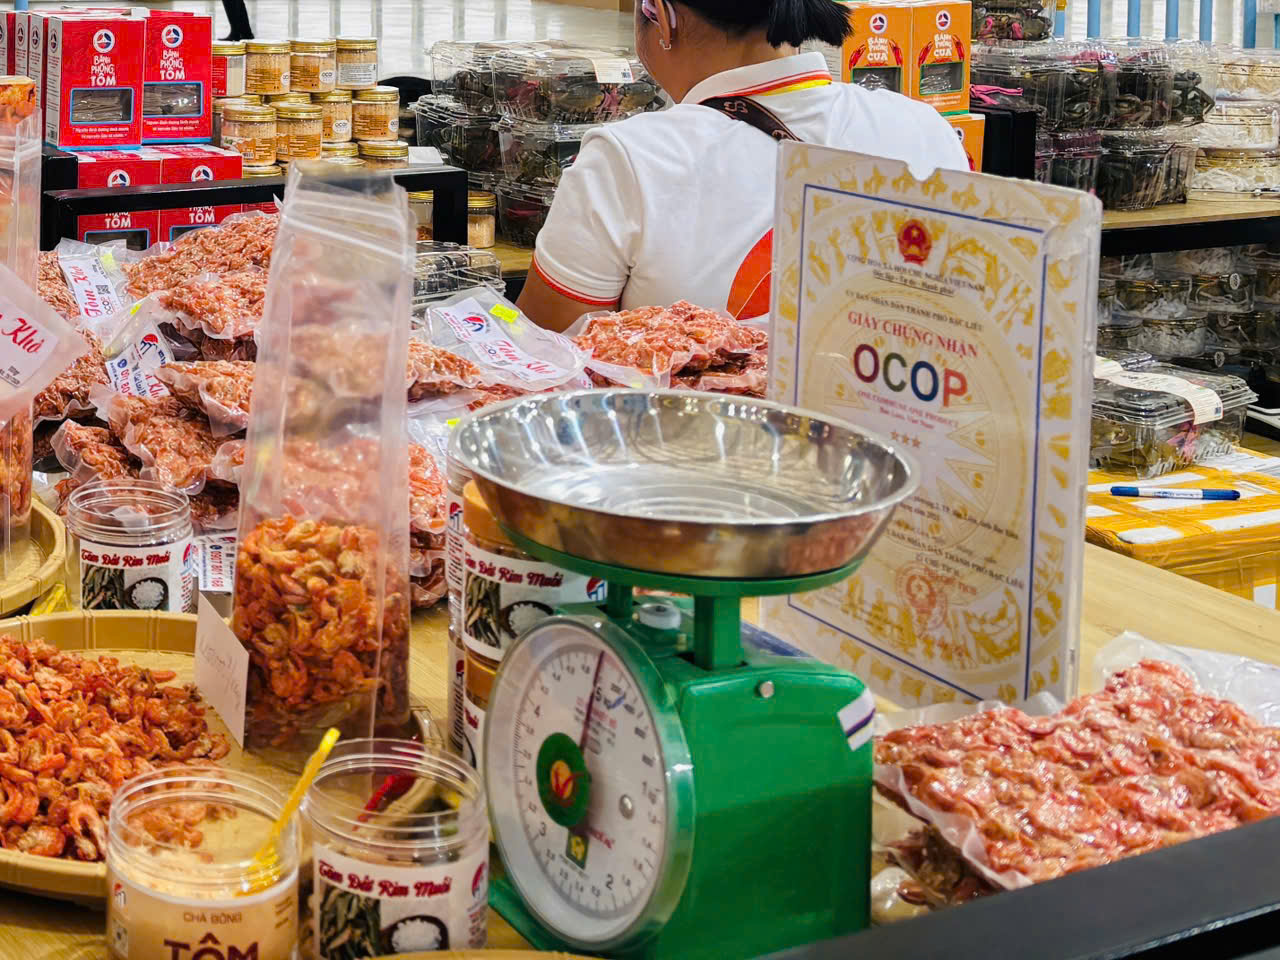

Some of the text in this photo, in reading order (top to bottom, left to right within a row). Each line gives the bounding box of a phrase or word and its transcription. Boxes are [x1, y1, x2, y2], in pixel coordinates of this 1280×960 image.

[867, 52, 888, 61] CUA
[933, 48, 952, 57] CUA
[90, 72, 116, 87] TÔM
[160, 67, 186, 81] TÔM
[105, 213, 132, 228] TÔM
[189, 208, 215, 224] TÔM
[1, 317, 45, 354] Khô
[882, 319, 934, 346] CHỨNG
[937, 334, 978, 359] NHẬN
[853, 343, 968, 408] OCOP
[81, 549, 99, 563] Tôm
[122, 554, 144, 567] Rim
[498, 566, 523, 584] Rim
[596, 686, 603, 703] 5
[318, 859, 452, 897] Tôm Đất Rim Muối
[606, 873, 613, 890] 2
[211, 912, 242, 924] BÔNG
[163, 932, 259, 960] TÔM
